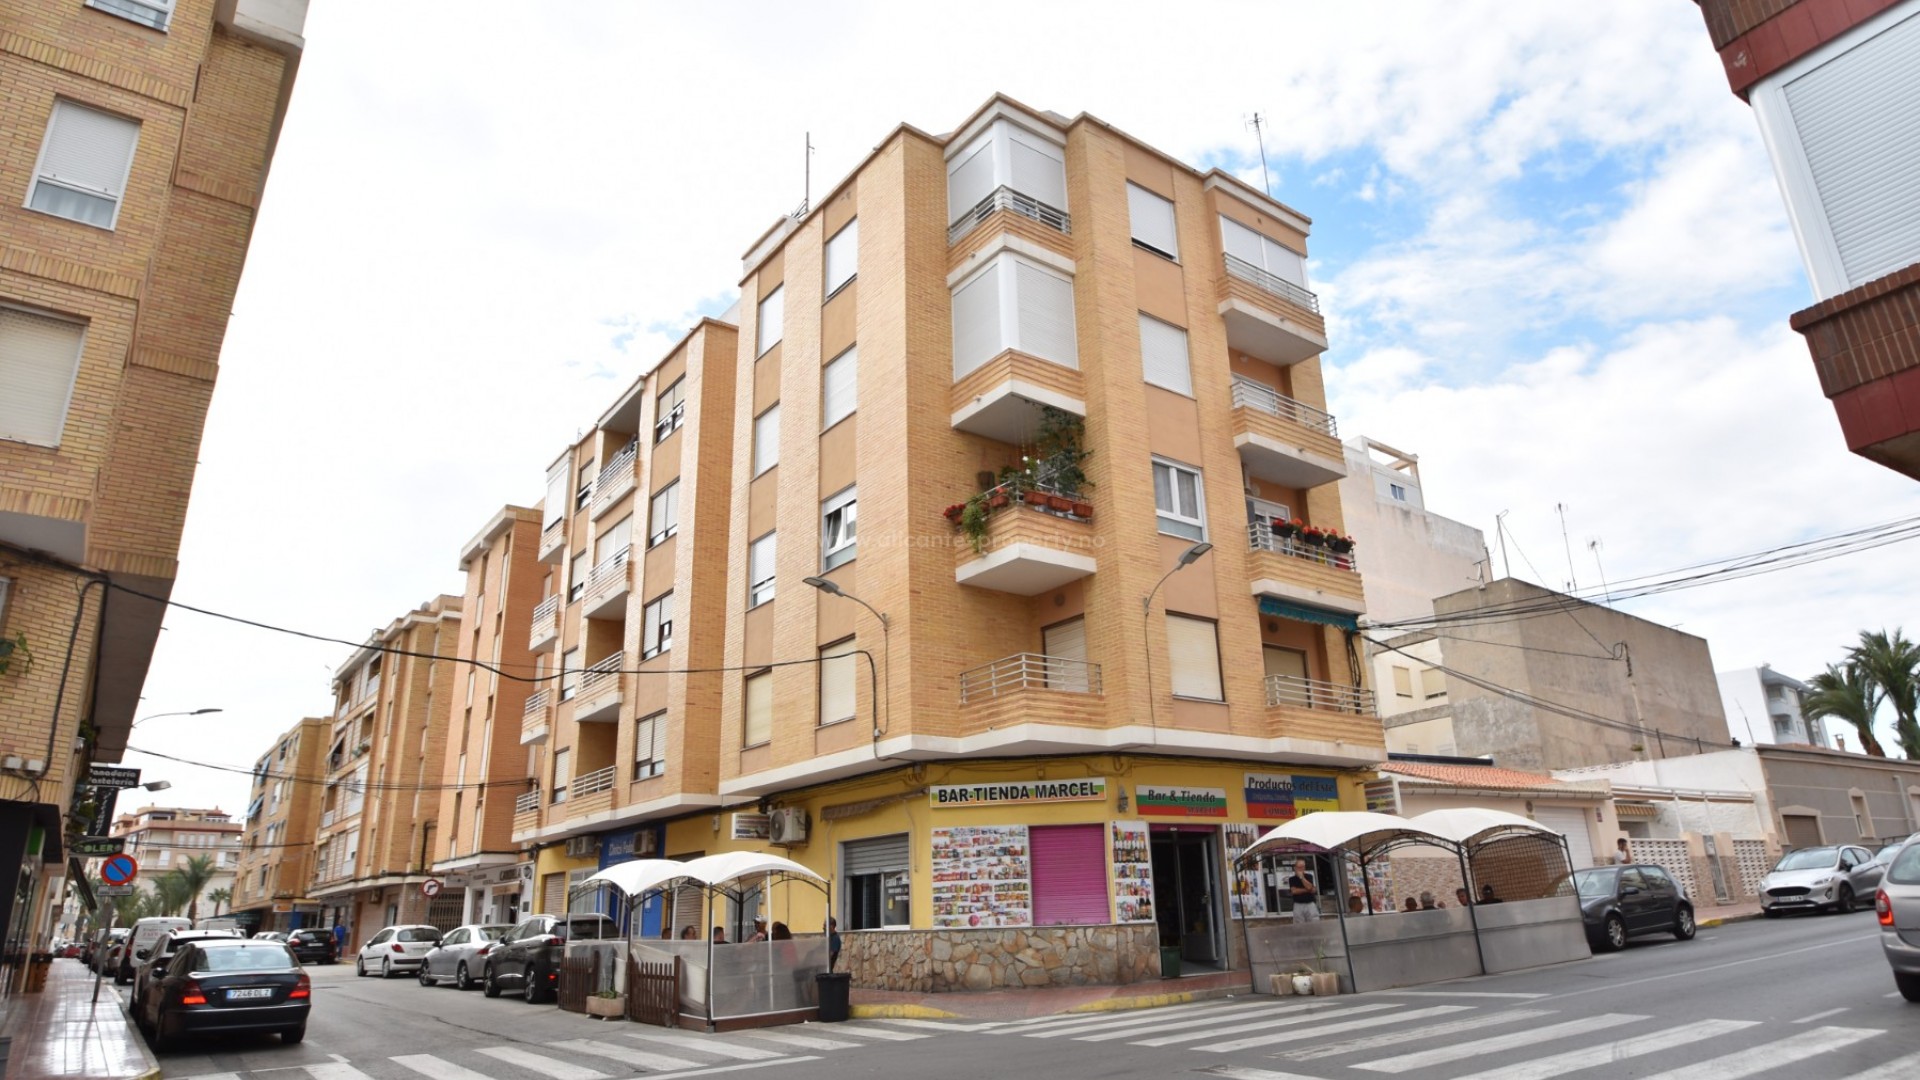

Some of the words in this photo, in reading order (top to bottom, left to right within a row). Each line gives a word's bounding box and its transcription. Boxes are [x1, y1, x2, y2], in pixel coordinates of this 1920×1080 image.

[1248, 776, 1297, 791] Productos
[938, 785, 1030, 803] BAR-TIENDA
[1035, 782, 1098, 799] MARCEL
[1148, 789, 1166, 801] Bar
[1169, 790, 1178, 802] &
[1180, 790, 1216, 803] Tienda
